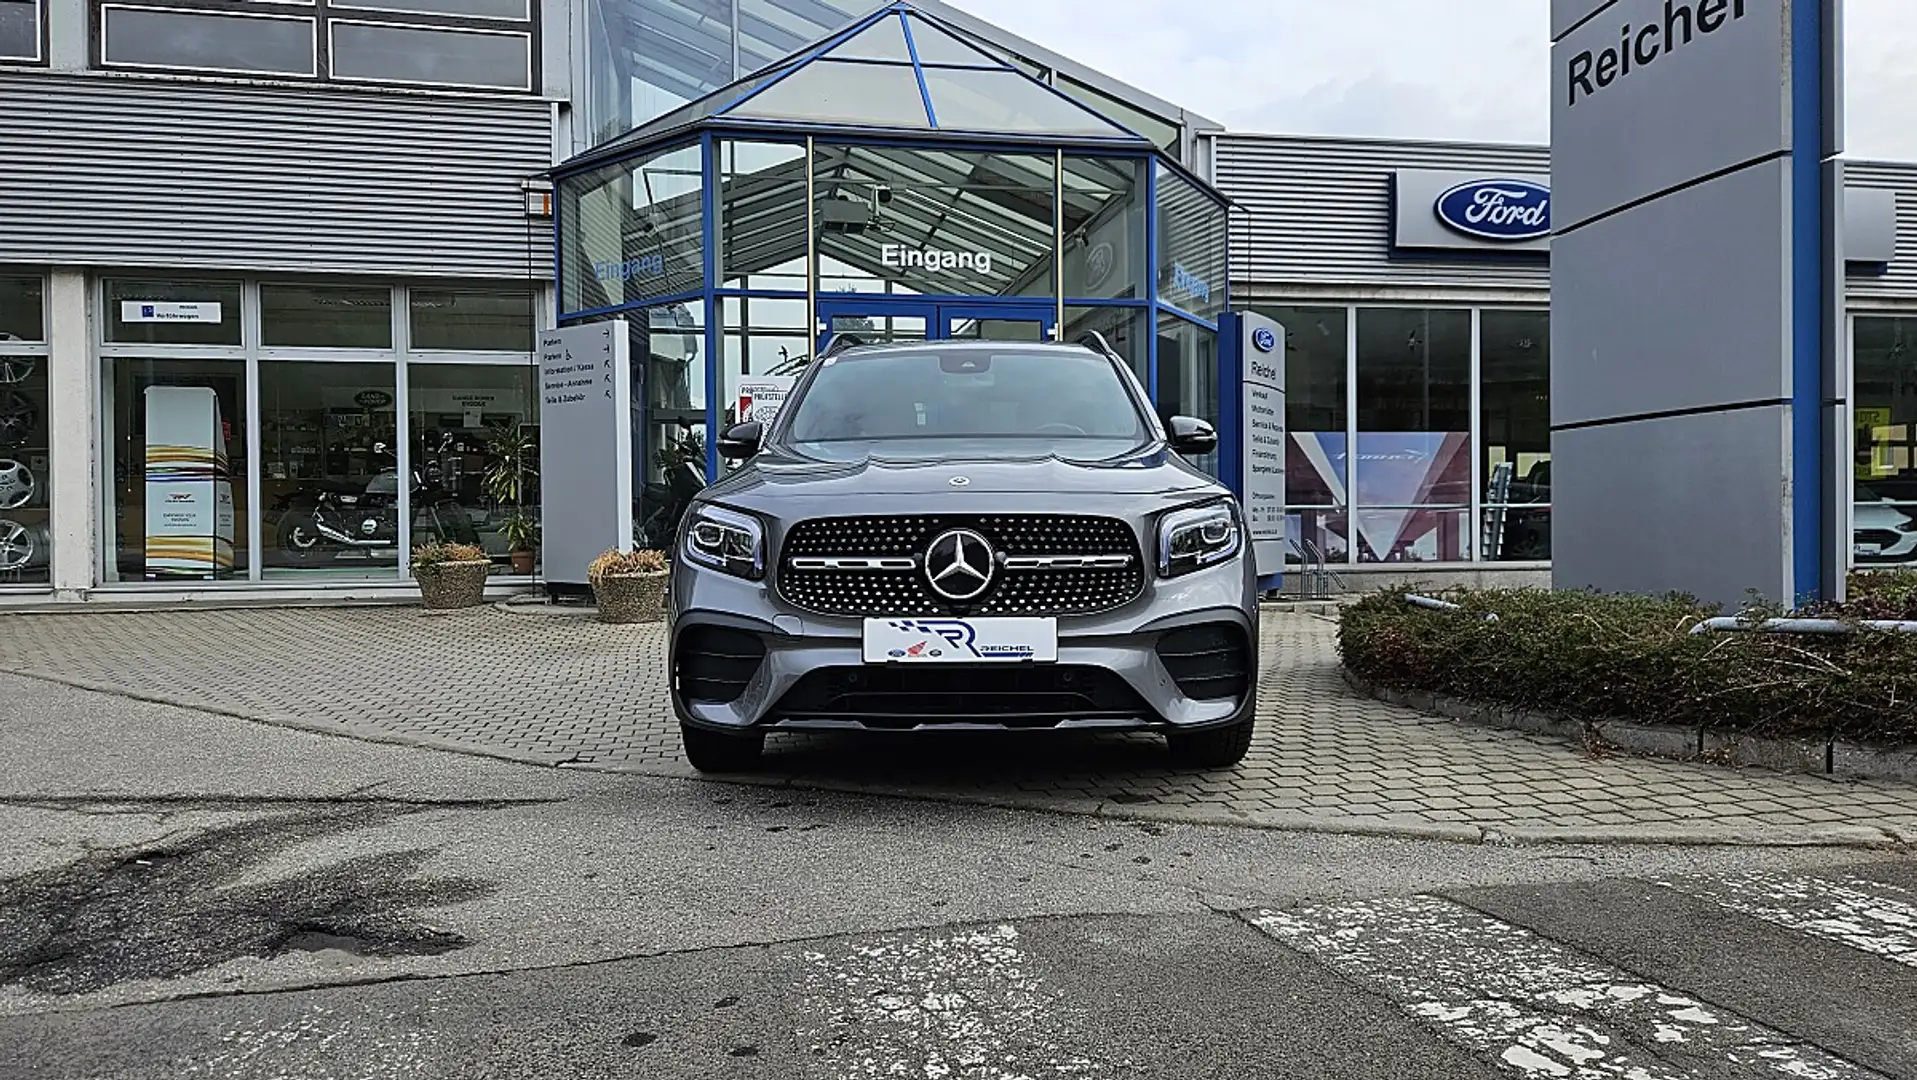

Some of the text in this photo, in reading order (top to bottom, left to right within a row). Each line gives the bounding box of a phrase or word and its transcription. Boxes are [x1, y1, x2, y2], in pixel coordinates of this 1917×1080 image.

[1465, 188, 1548, 226] Ford
[594, 255, 663, 281] Eingang
[882, 243, 991, 274] Eingang
